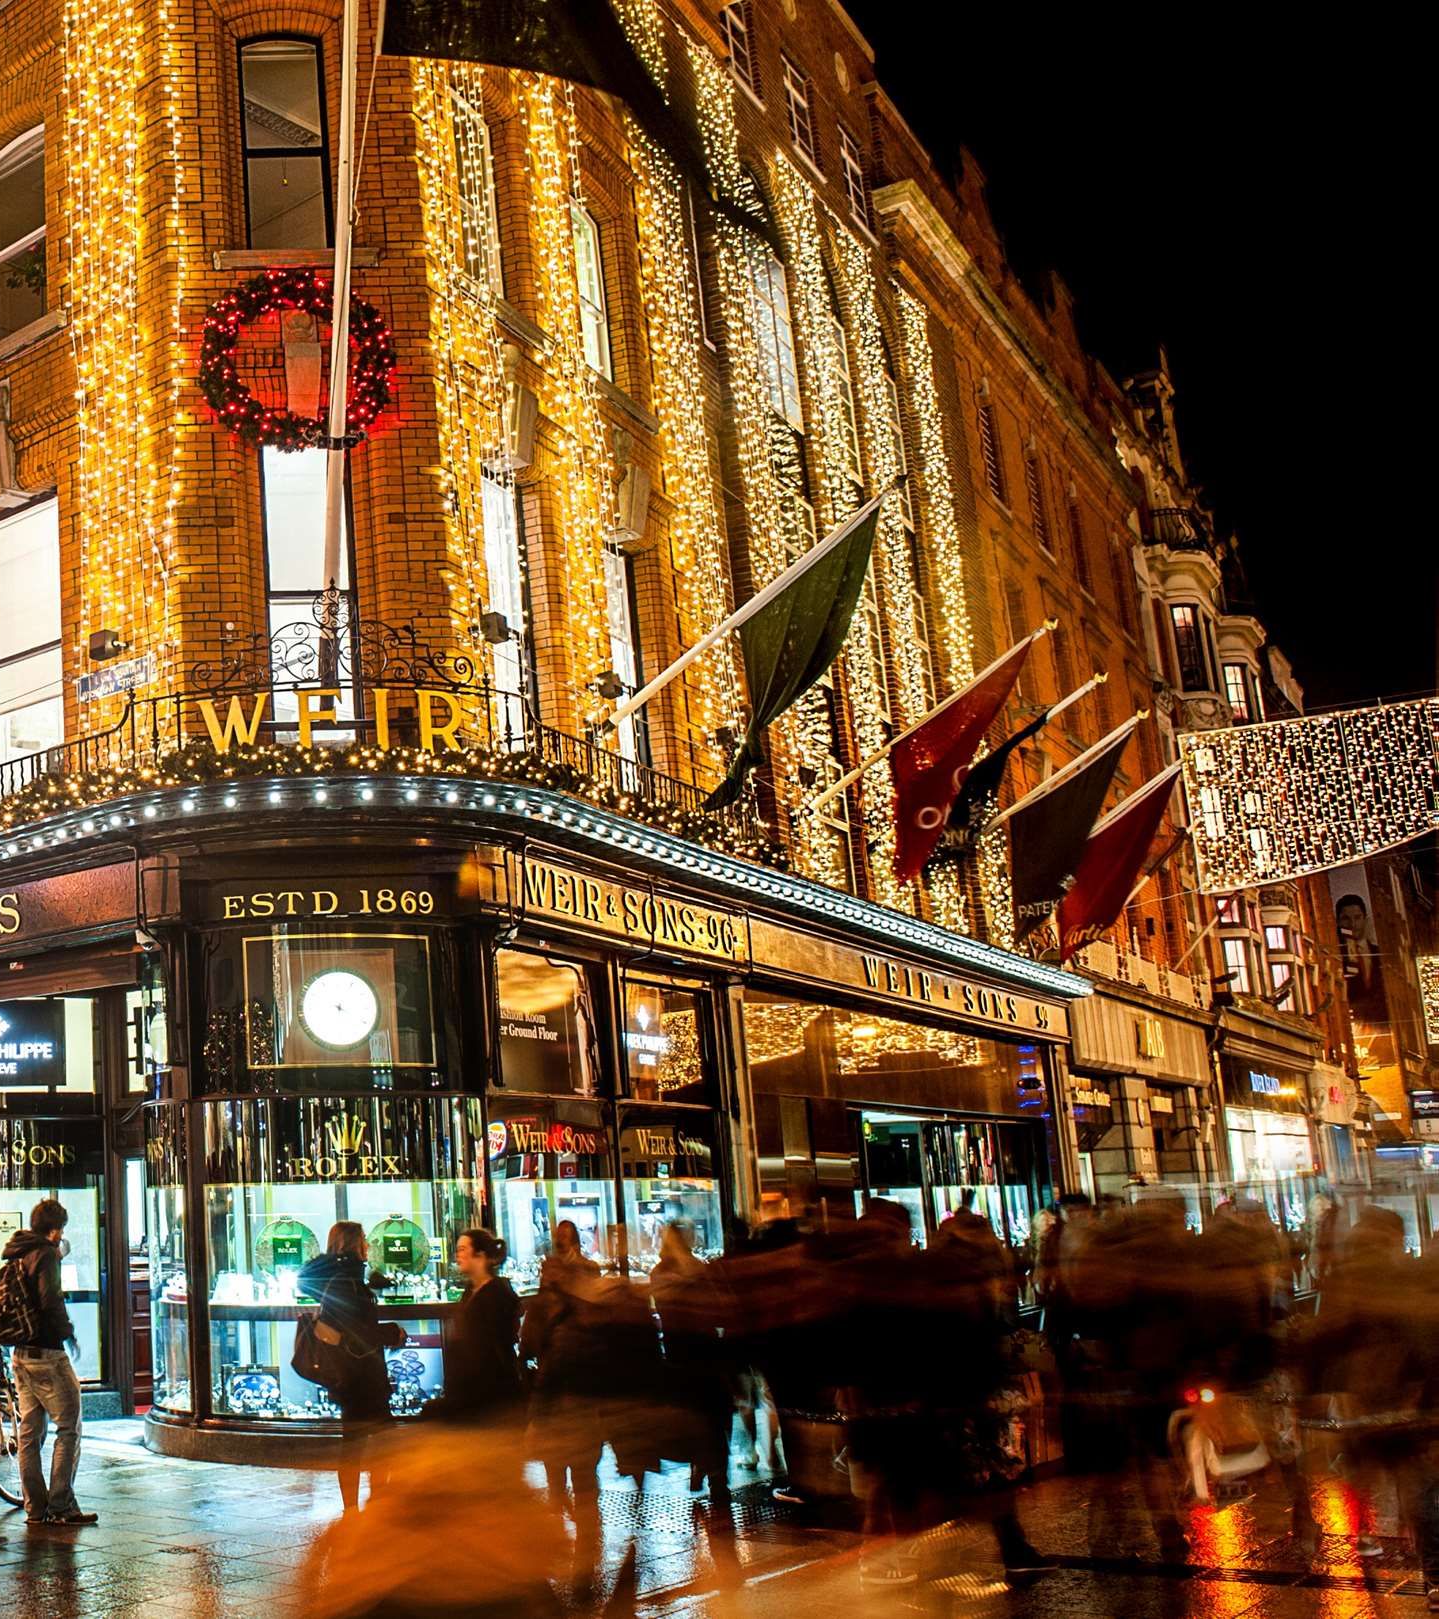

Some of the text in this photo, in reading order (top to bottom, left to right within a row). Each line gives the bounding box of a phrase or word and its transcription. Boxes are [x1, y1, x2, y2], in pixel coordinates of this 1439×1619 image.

[198, 687, 464, 752] WEIR
[223, 888, 434, 919] ESTD 1869
[524, 860, 603, 923] WEIR
[607, 894, 618, 917] &
[1018, 898, 1060, 919] PATEK
[863, 955, 932, 1001] WEIR
[963, 984, 1017, 1023] SONS
[509, 1023, 537, 1038] Ground
[539, 1027, 558, 1041] Floor
[525, 1012, 546, 1024] Room
[511, 1123, 551, 1153] WEIR
[564, 1126, 596, 1155] SONS
[636, 1129, 666, 1156] WEIR
[667, 1139, 678, 1156] &
[291, 1155, 402, 1177] ROLEX
